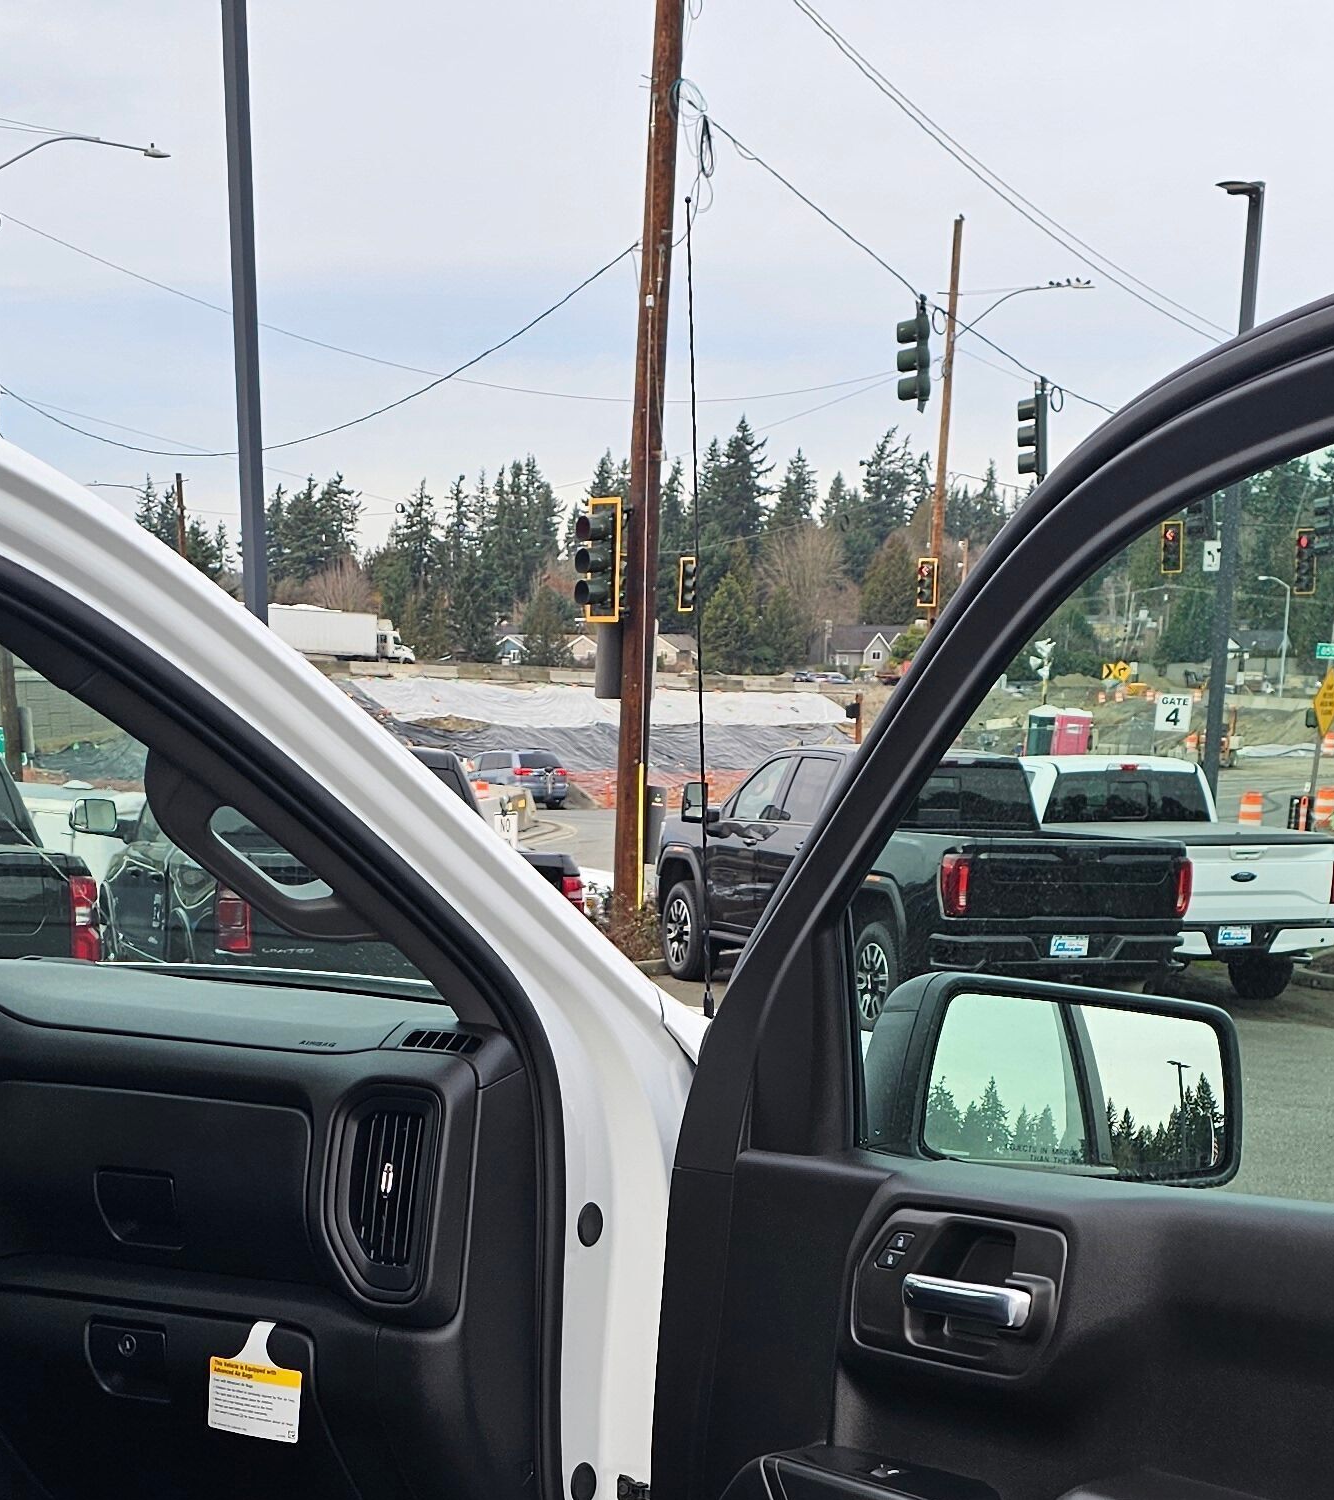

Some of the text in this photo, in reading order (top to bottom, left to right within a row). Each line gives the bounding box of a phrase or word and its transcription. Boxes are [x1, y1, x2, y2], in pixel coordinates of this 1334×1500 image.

[1162, 697, 1189, 706] GATE
[1165, 707, 1180, 726] 4
[500, 818, 510, 832] NO
[1040, 1145, 1048, 1154] IN
[1030, 1154, 1050, 1163] THAN
[213, 1366, 234, 1376] Advanced
[214, 1359, 224, 1367] This
[225, 1360, 240, 1369] Vehicle
[244, 1364, 266, 1375] Equipped
